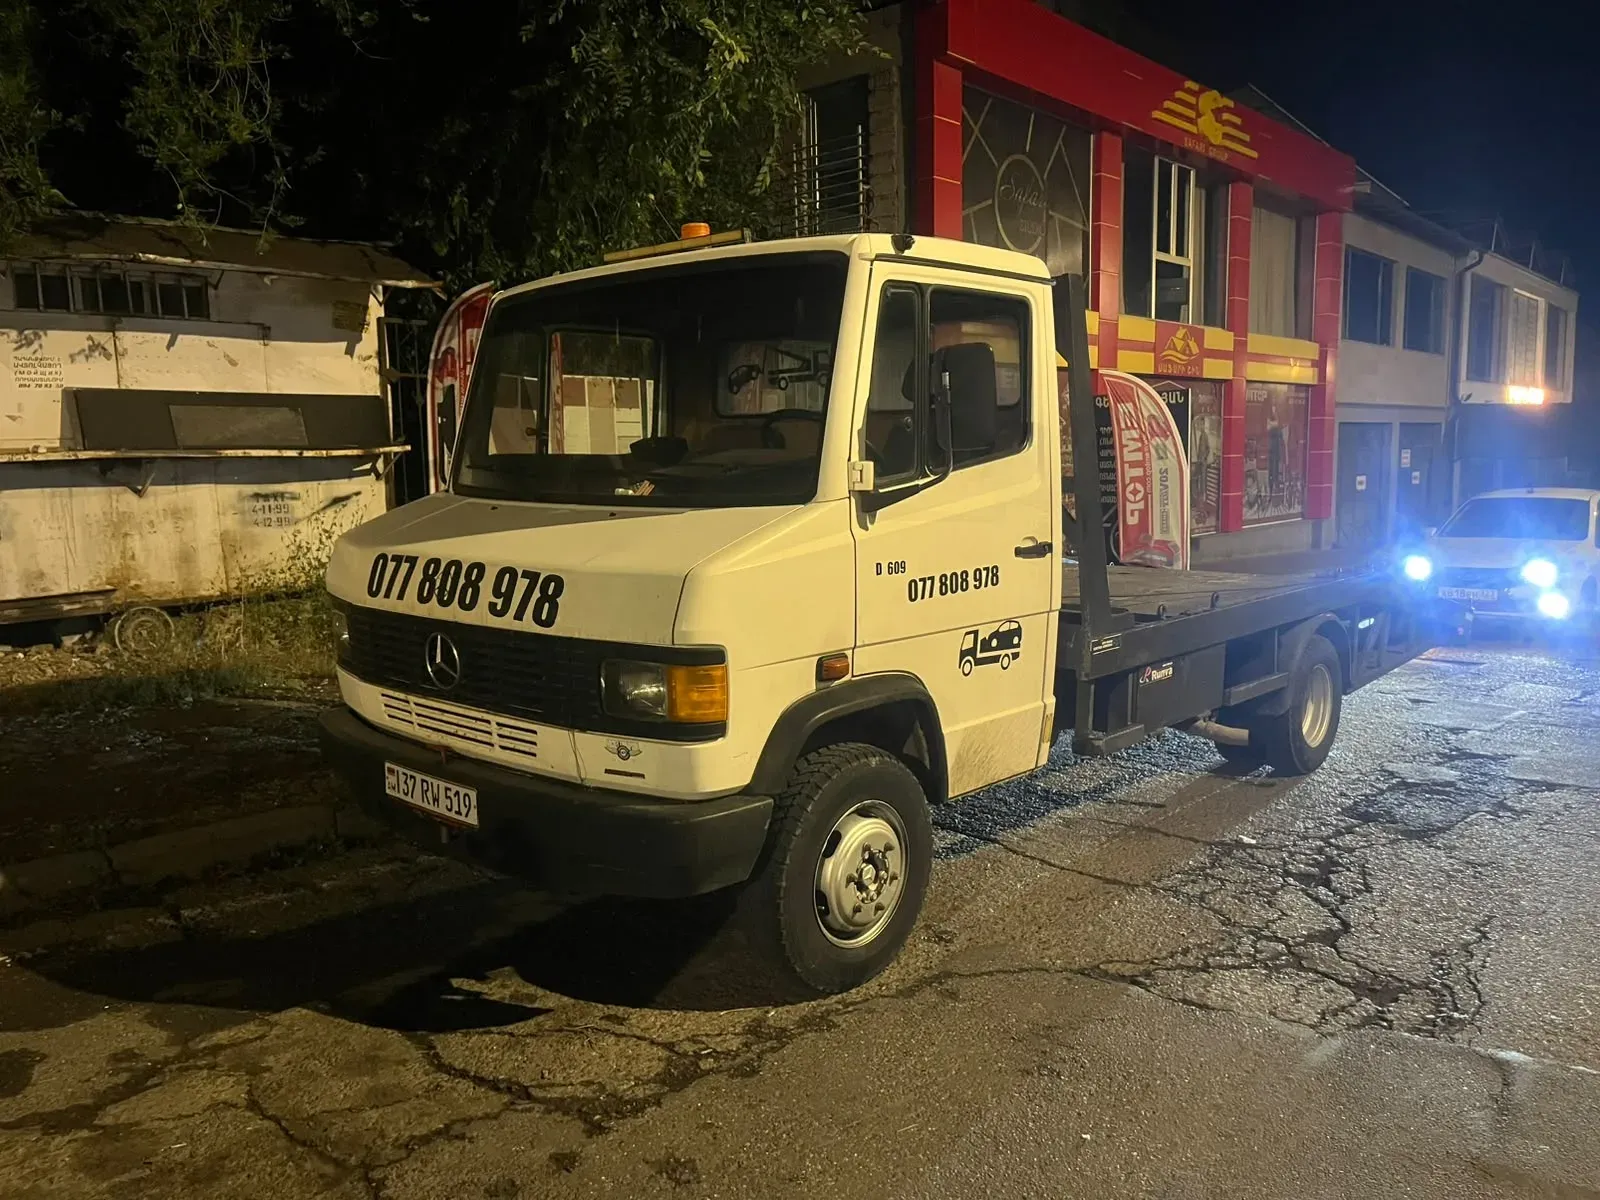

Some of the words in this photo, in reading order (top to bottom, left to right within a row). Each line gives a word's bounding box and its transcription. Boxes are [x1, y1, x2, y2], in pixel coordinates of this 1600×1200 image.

[875, 562, 883, 576] D
[887, 560, 906, 575] 609
[907, 575, 936, 602] 077
[939, 569, 969, 596] 808
[973, 565, 999, 590] 978
[367, 553, 419, 601] 077
[417, 557, 486, 612] 808
[488, 566, 565, 628] 978
[420, 779, 440, 808] RW
[444, 786, 472, 818] 519
